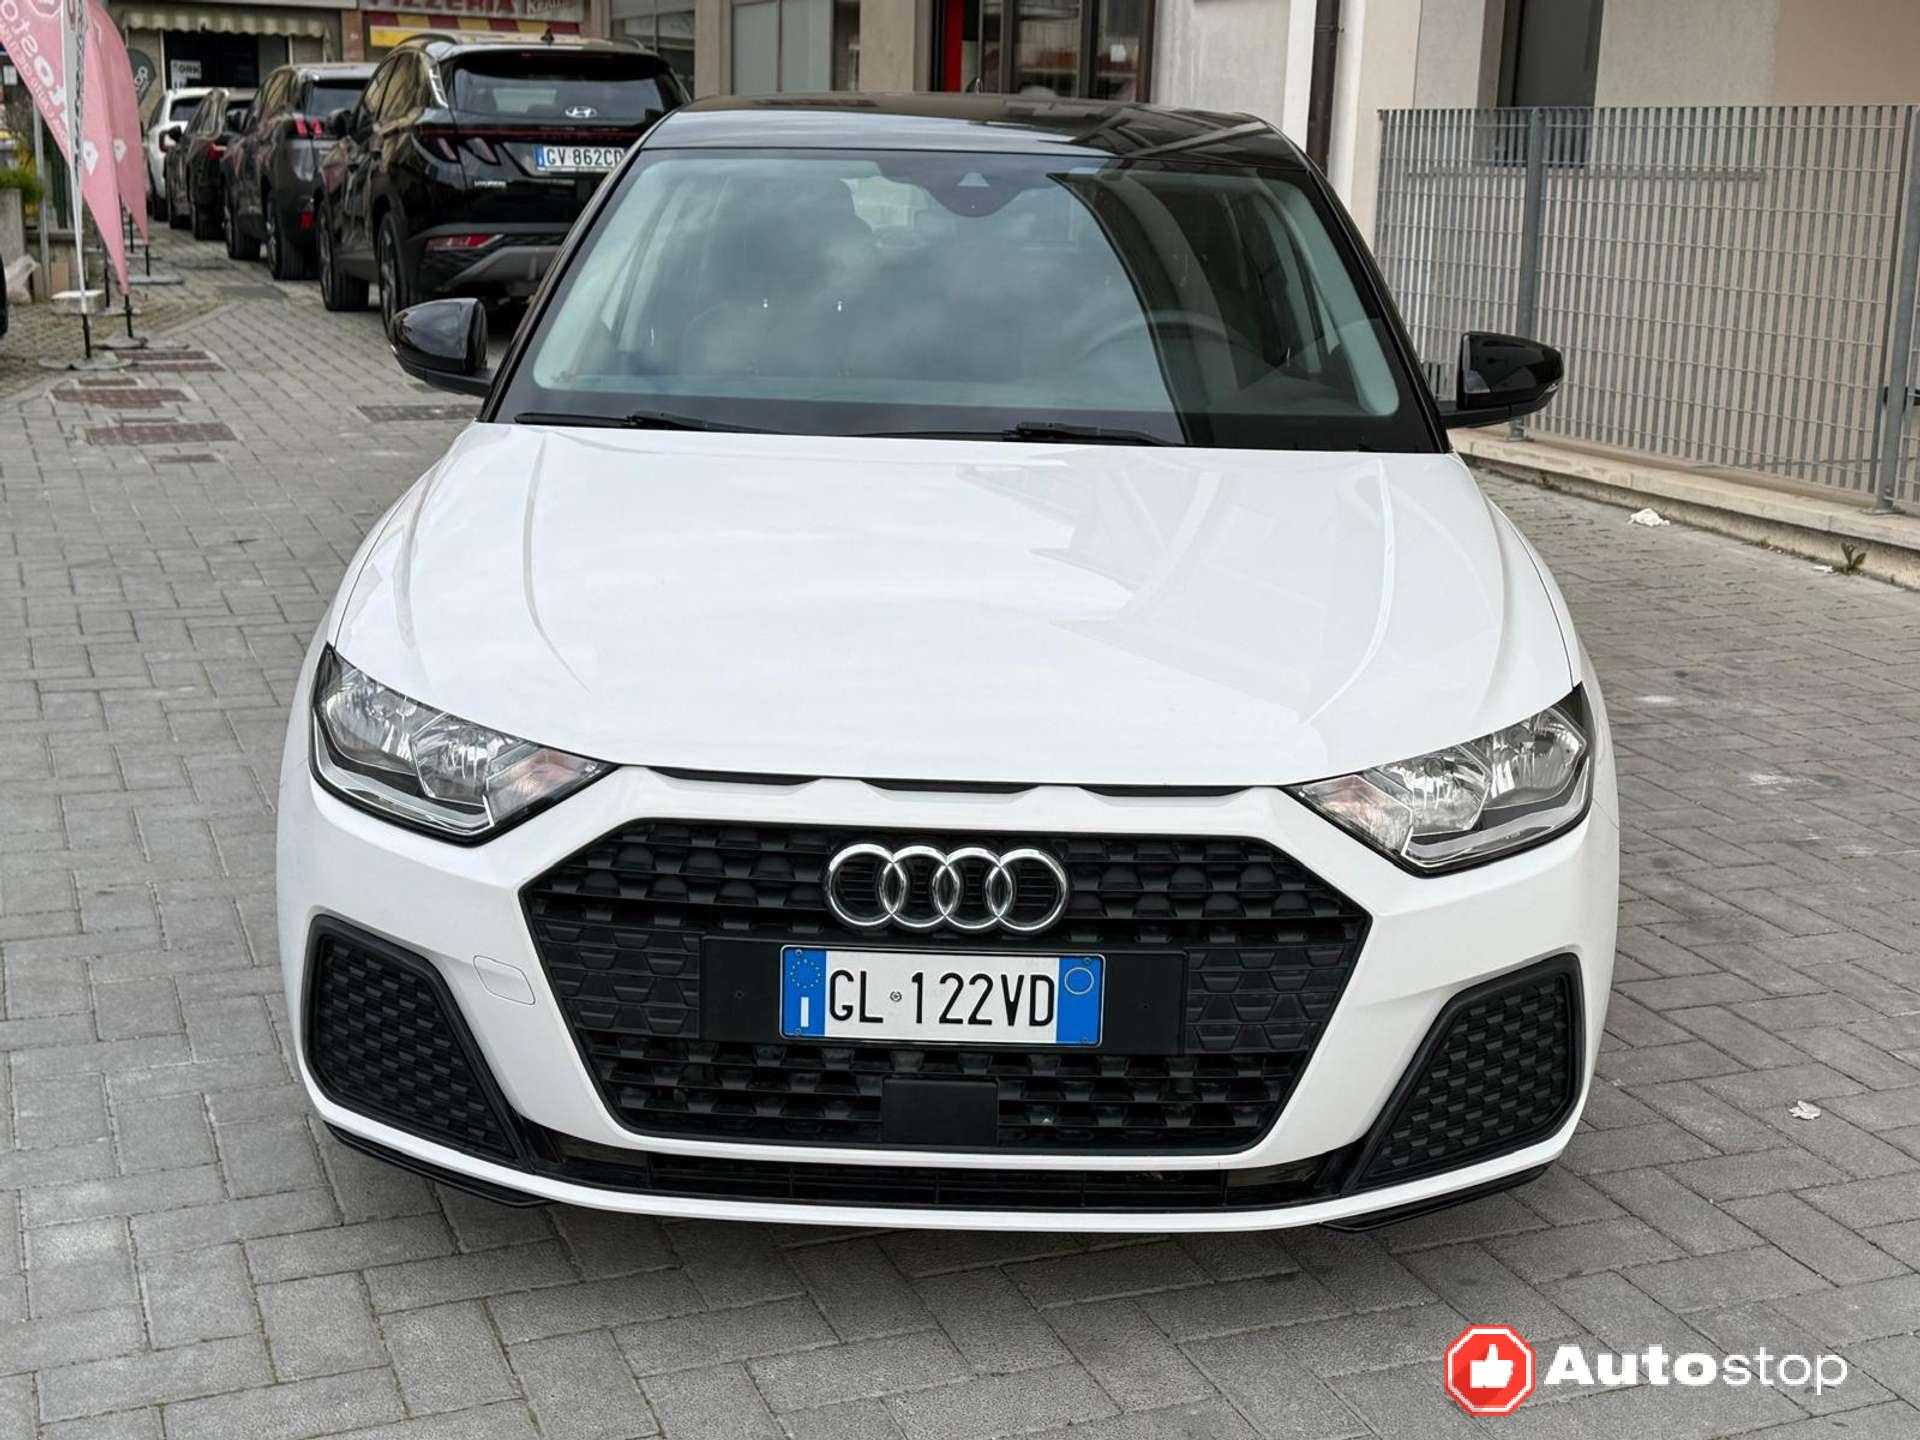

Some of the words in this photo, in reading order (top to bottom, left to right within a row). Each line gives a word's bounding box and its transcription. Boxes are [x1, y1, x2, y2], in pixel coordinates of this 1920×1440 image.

[368, 0, 516, 14] ERIA
[829, 969, 884, 1023] GL
[911, 971, 1055, 1027] 122VD
